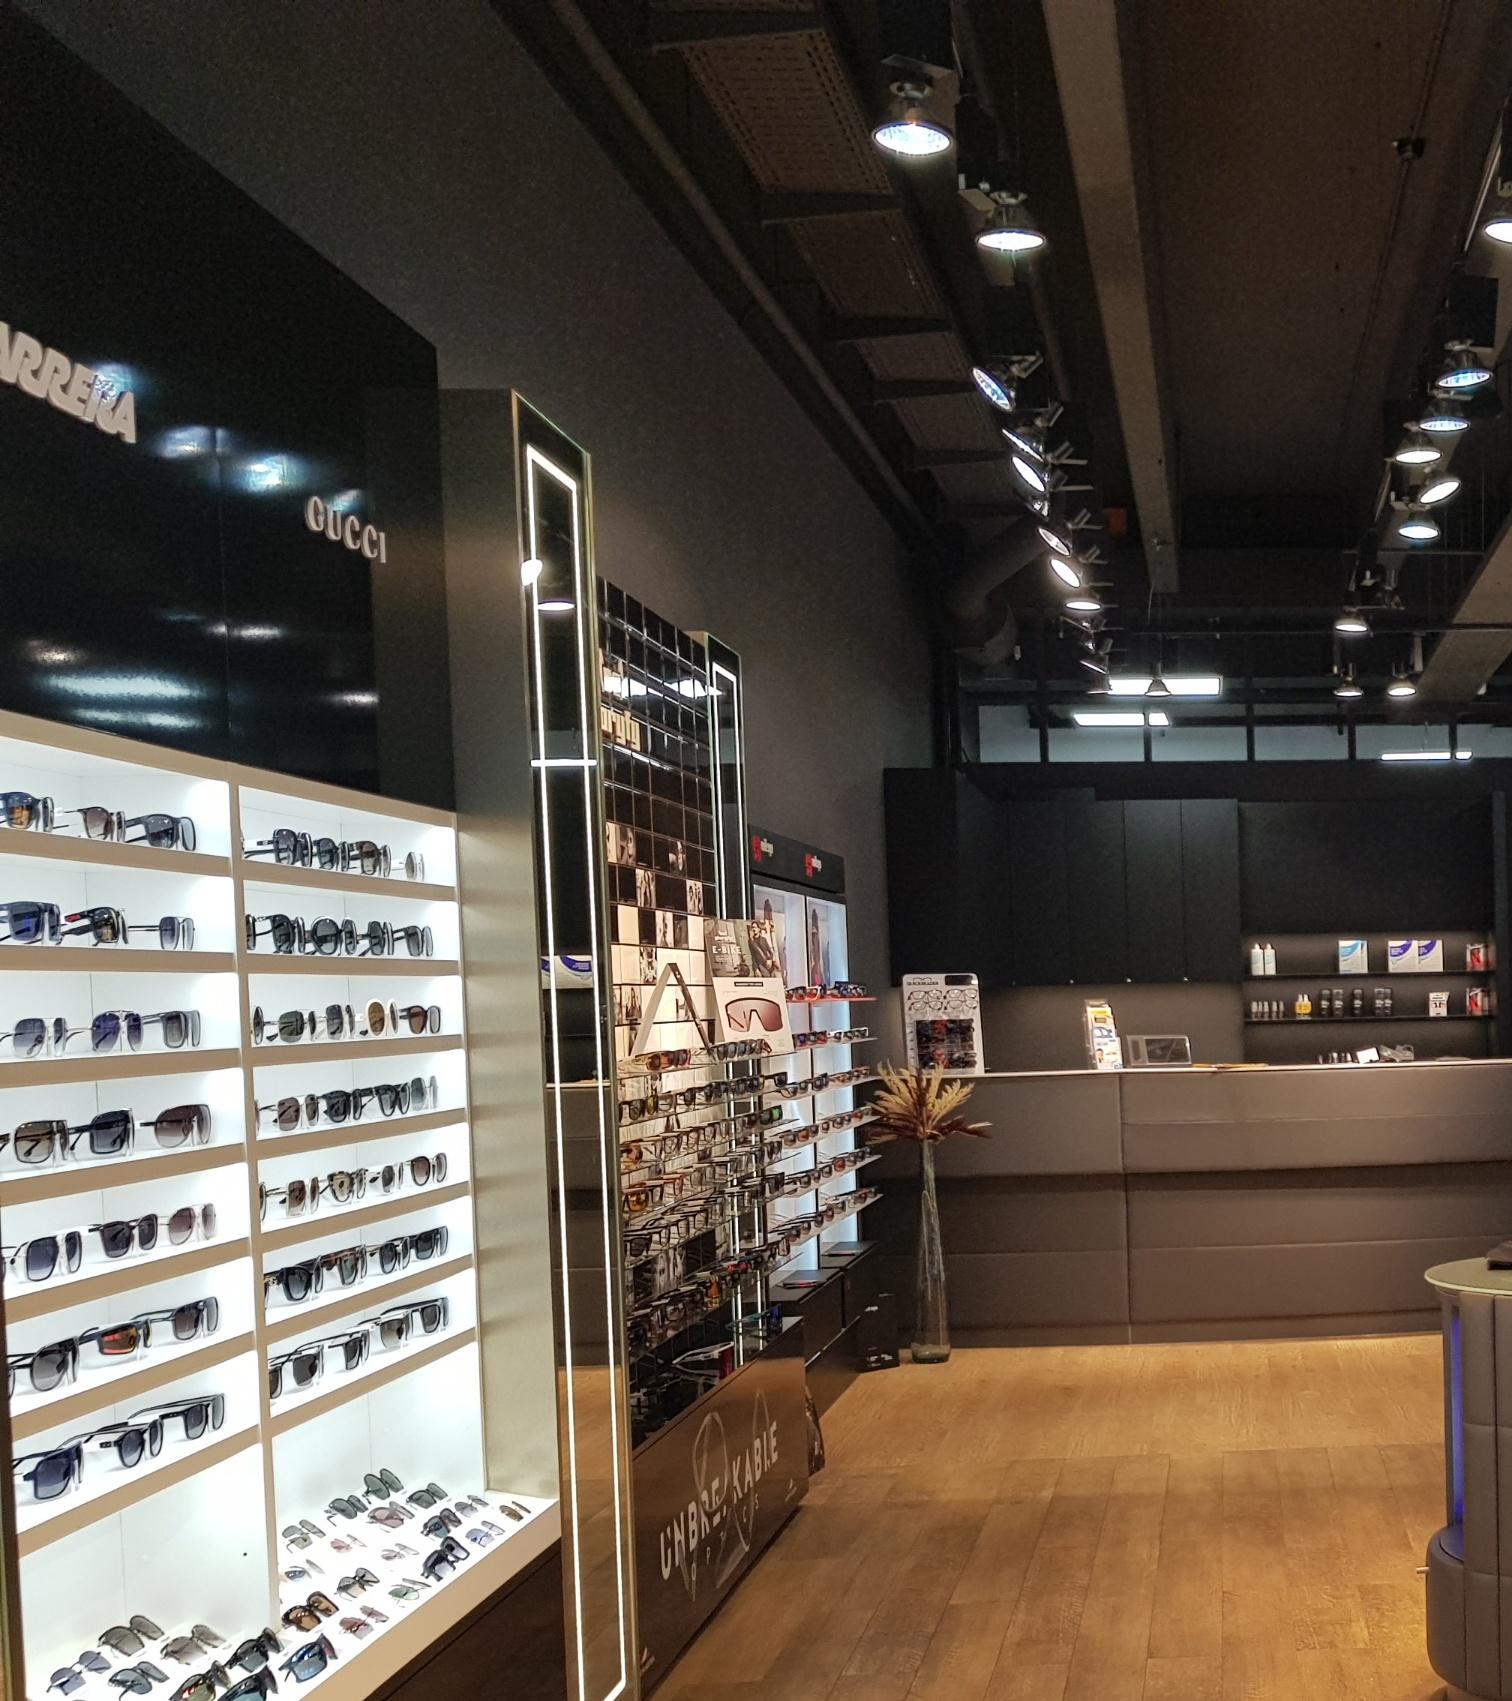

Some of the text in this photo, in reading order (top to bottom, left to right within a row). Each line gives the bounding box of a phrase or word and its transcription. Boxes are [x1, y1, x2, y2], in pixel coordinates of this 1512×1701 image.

[305, 495, 386, 564] GUCCI
[712, 945, 742, 955] E-BIKE
[660, 1420, 779, 1581] UNBREKABLE
